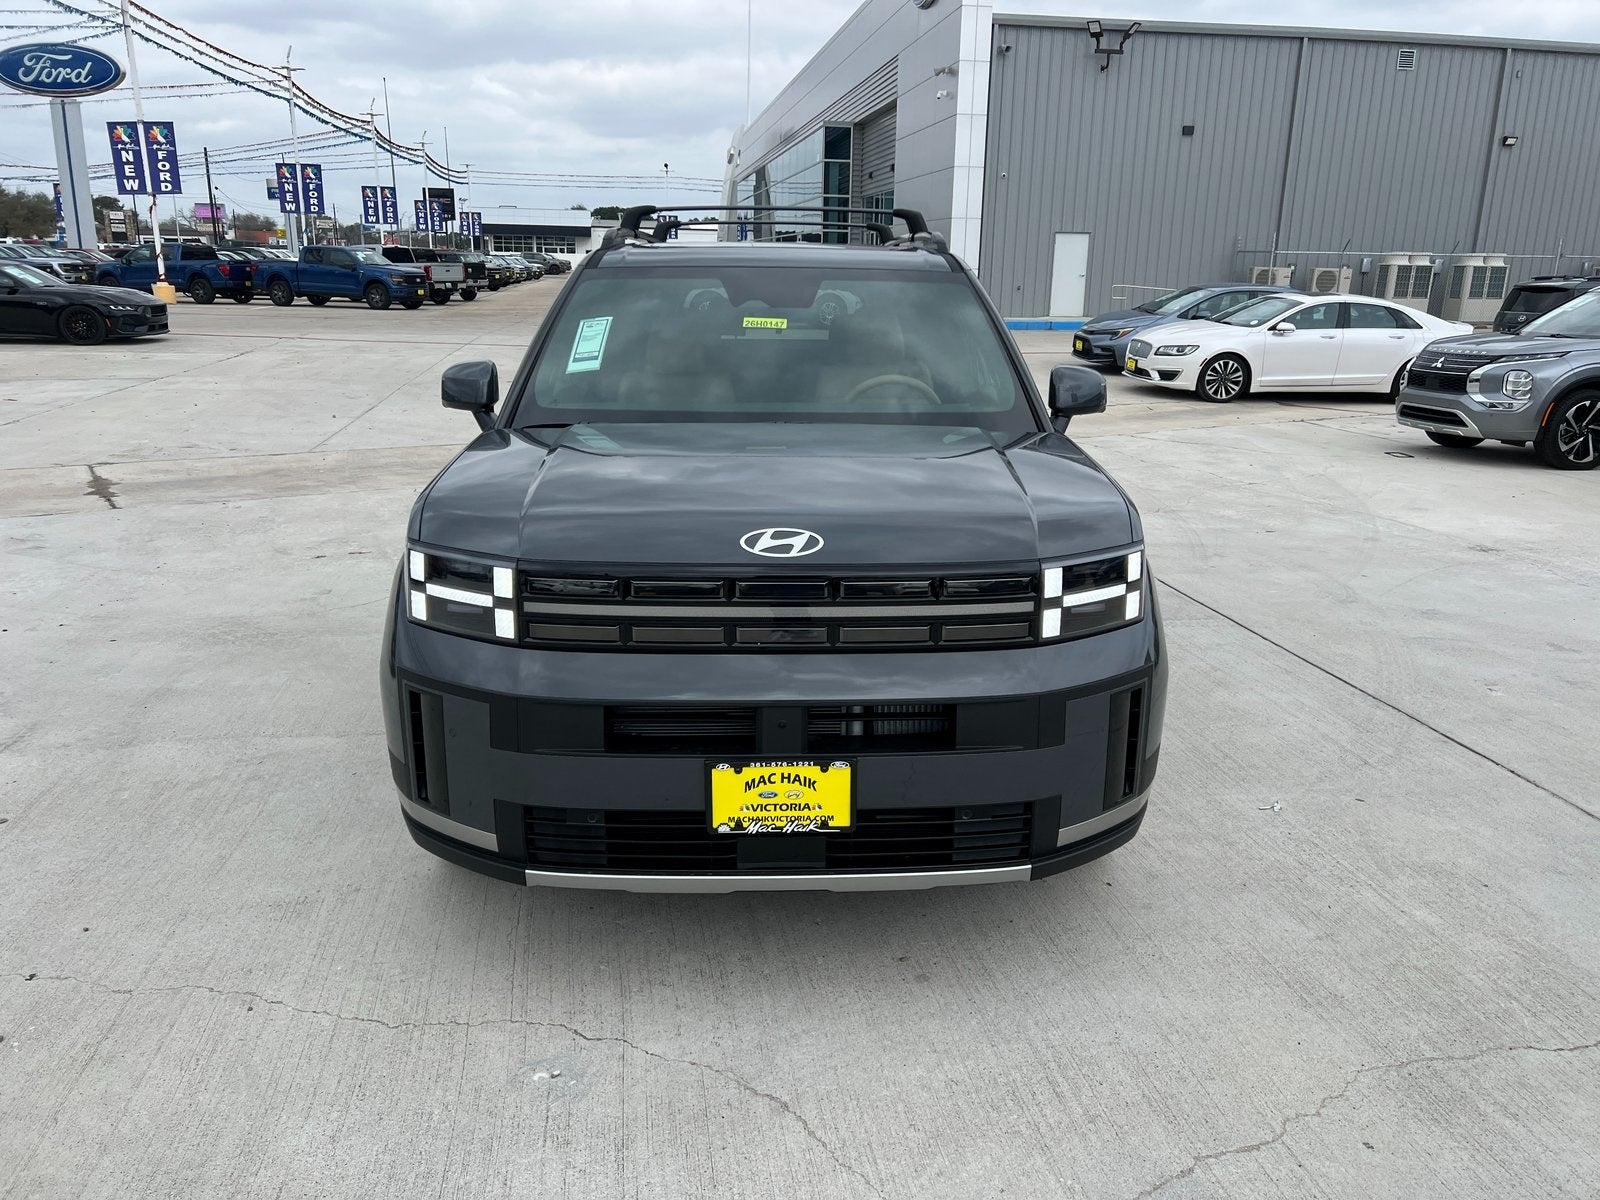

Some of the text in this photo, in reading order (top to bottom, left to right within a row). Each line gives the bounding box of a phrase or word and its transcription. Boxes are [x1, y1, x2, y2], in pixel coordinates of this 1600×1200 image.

[18, 52, 92, 84] Ford
[121, 150, 139, 191] NEW
[157, 150, 172, 192] FORD
[284, 183, 296, 211] NEW
[308, 183, 319, 212] FORD
[367, 201, 377, 223] NEW
[386, 201, 394, 223] FORD
[418, 212, 426, 230] NEW
[744, 320, 785, 328] 26H0147
[744, 772, 818, 793] MAC HAIK
[750, 803, 812, 812] VICTORIA
[745, 819, 820, 834] Mac Haik
